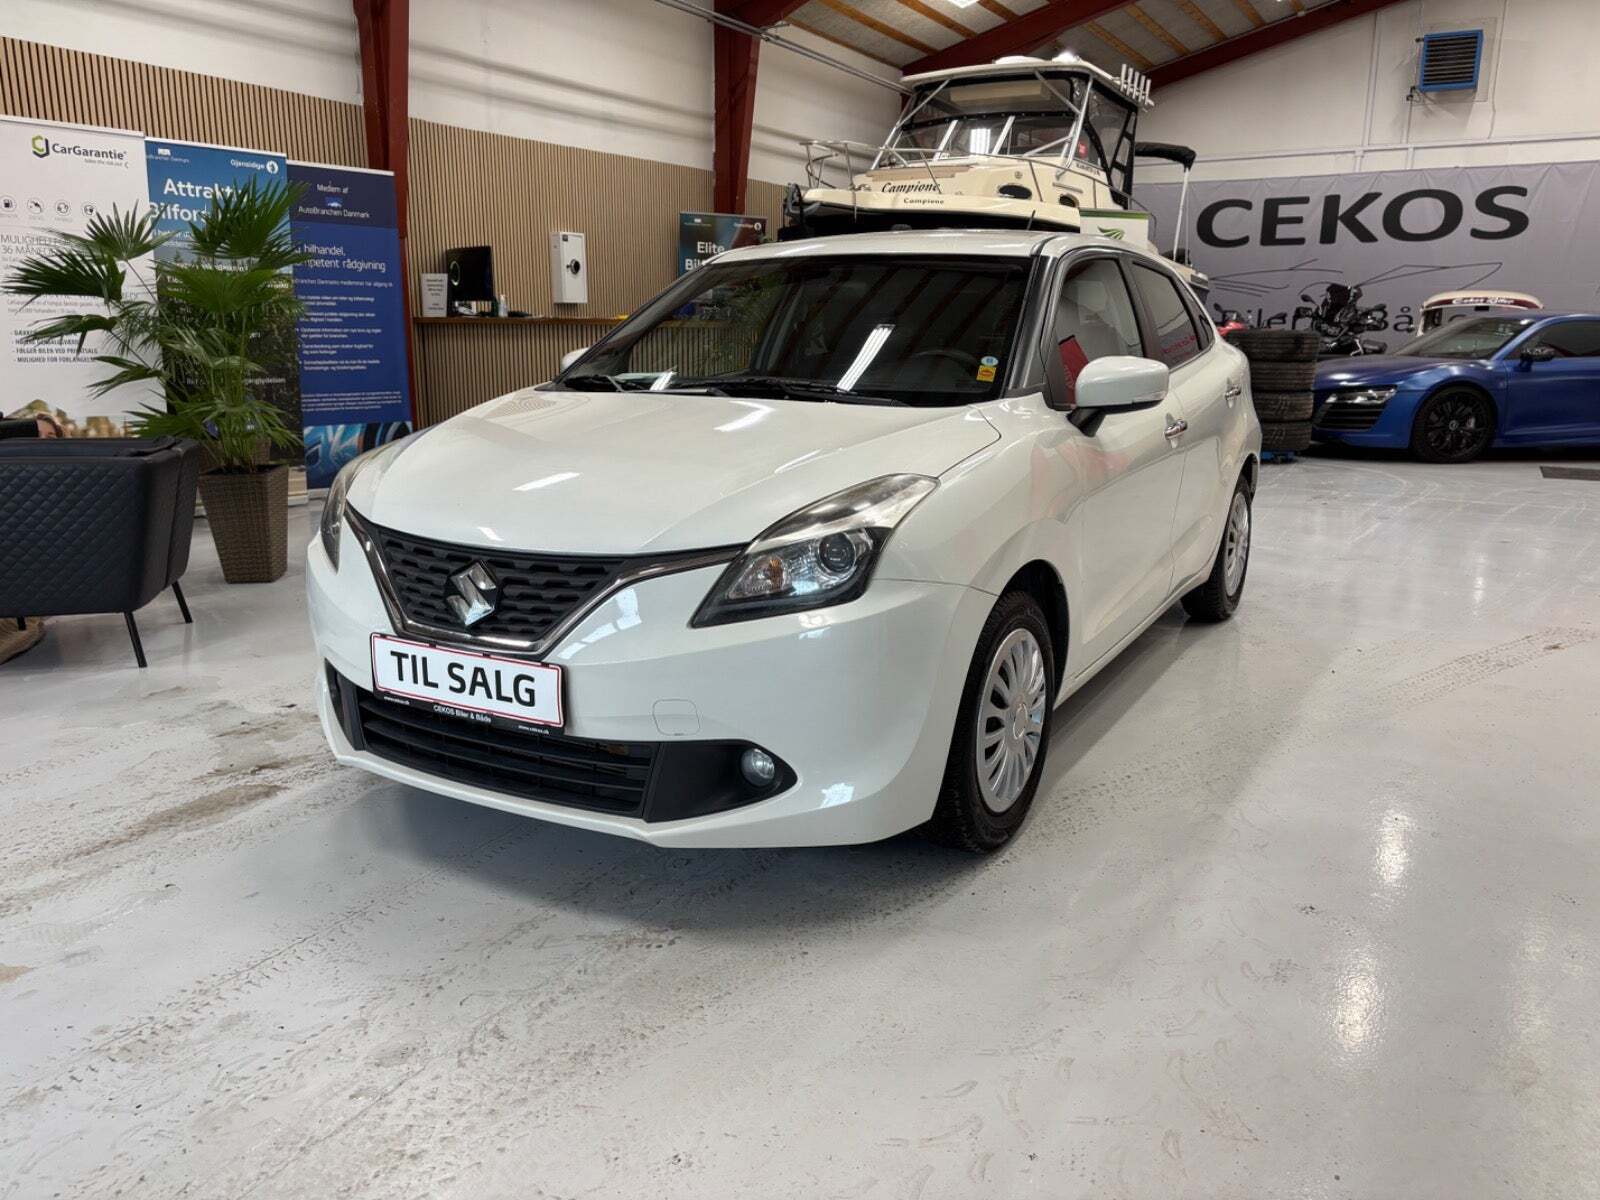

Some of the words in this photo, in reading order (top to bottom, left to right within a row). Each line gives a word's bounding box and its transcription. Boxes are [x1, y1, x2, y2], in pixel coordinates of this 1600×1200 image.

[52, 143, 124, 160] CarGarantie
[230, 158, 265, 170] Gjensidige
[163, 178, 243, 200] Attrakt
[881, 181, 940, 194] Campione
[1195, 185, 1530, 249] CEKOS
[697, 241, 725, 254] Elite
[342, 259, 386, 273] rådgivning
[685, 258, 702, 270] Bil
[390, 650, 439, 689] TIL
[447, 662, 536, 707] SALG
[433, 705, 455, 716] CEKOS
[470, 712, 475, 720] &
